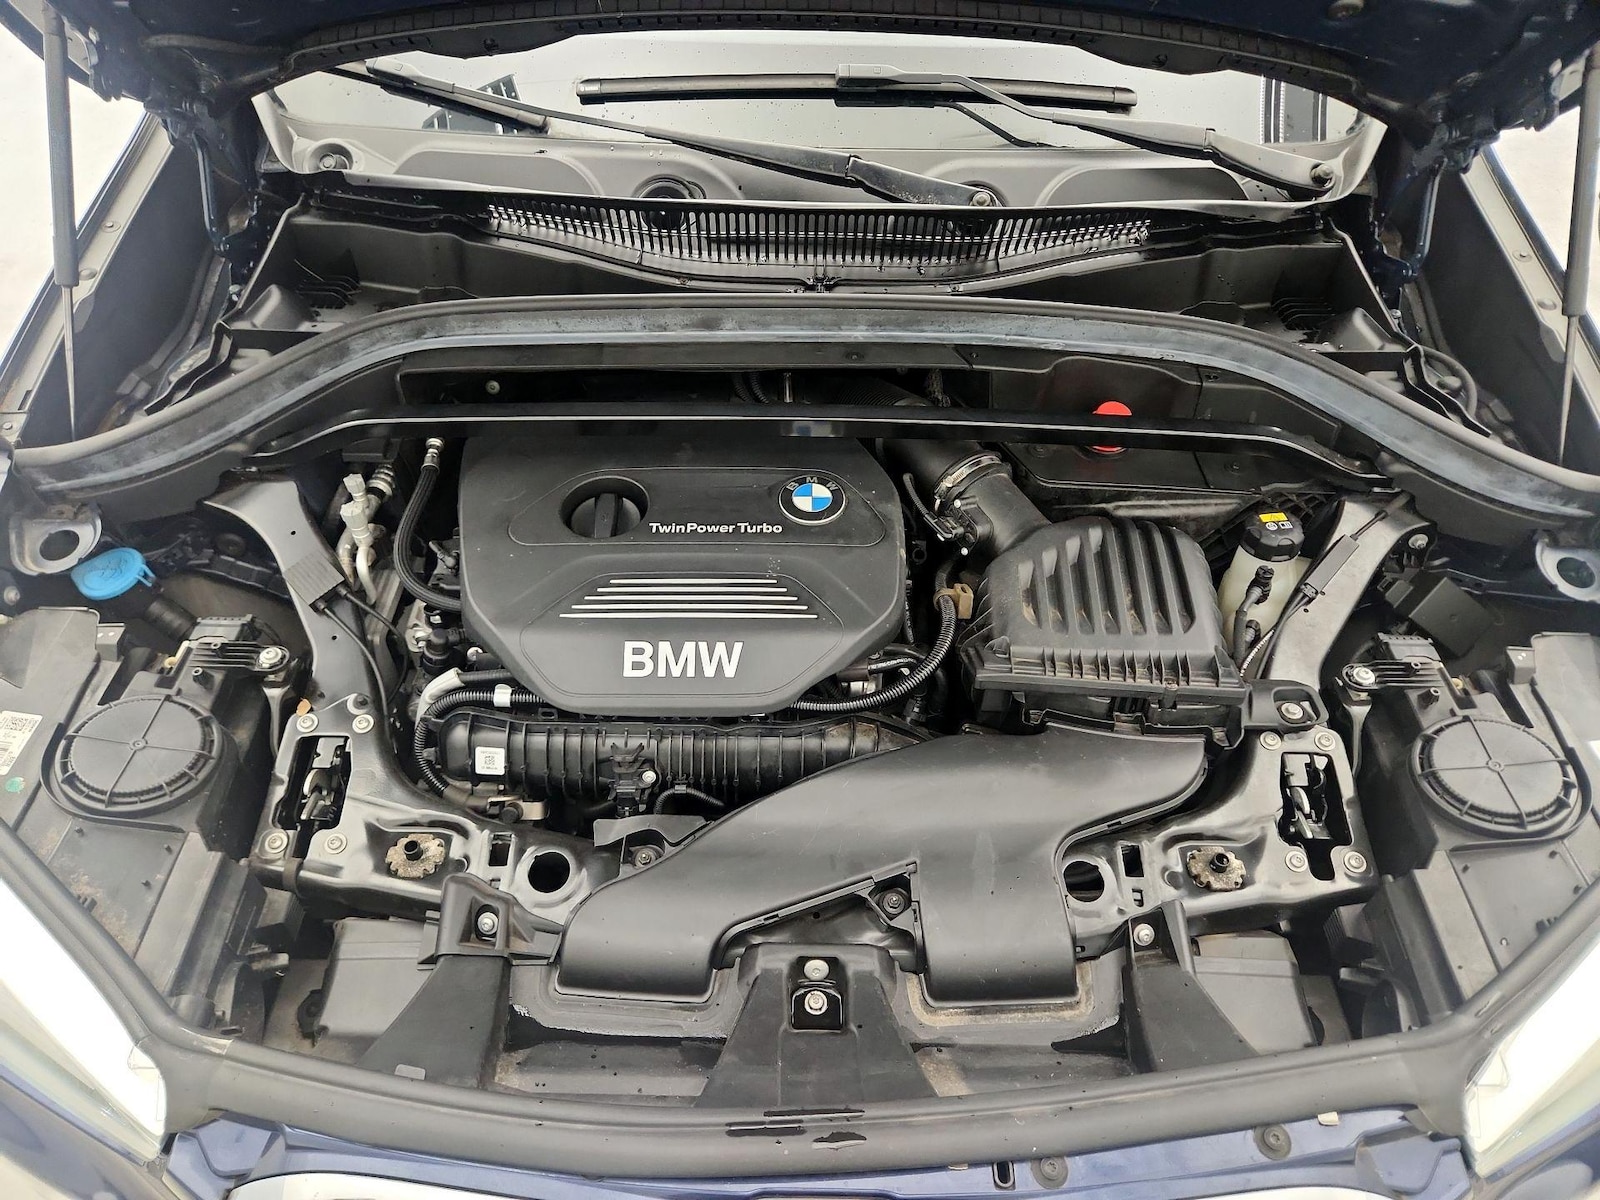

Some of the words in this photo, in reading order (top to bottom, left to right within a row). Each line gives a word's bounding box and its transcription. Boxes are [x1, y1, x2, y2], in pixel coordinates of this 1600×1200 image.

[786, 476, 839, 491] BMW
[737, 522, 783, 534] Turbo
[623, 640, 744, 678] BMW
